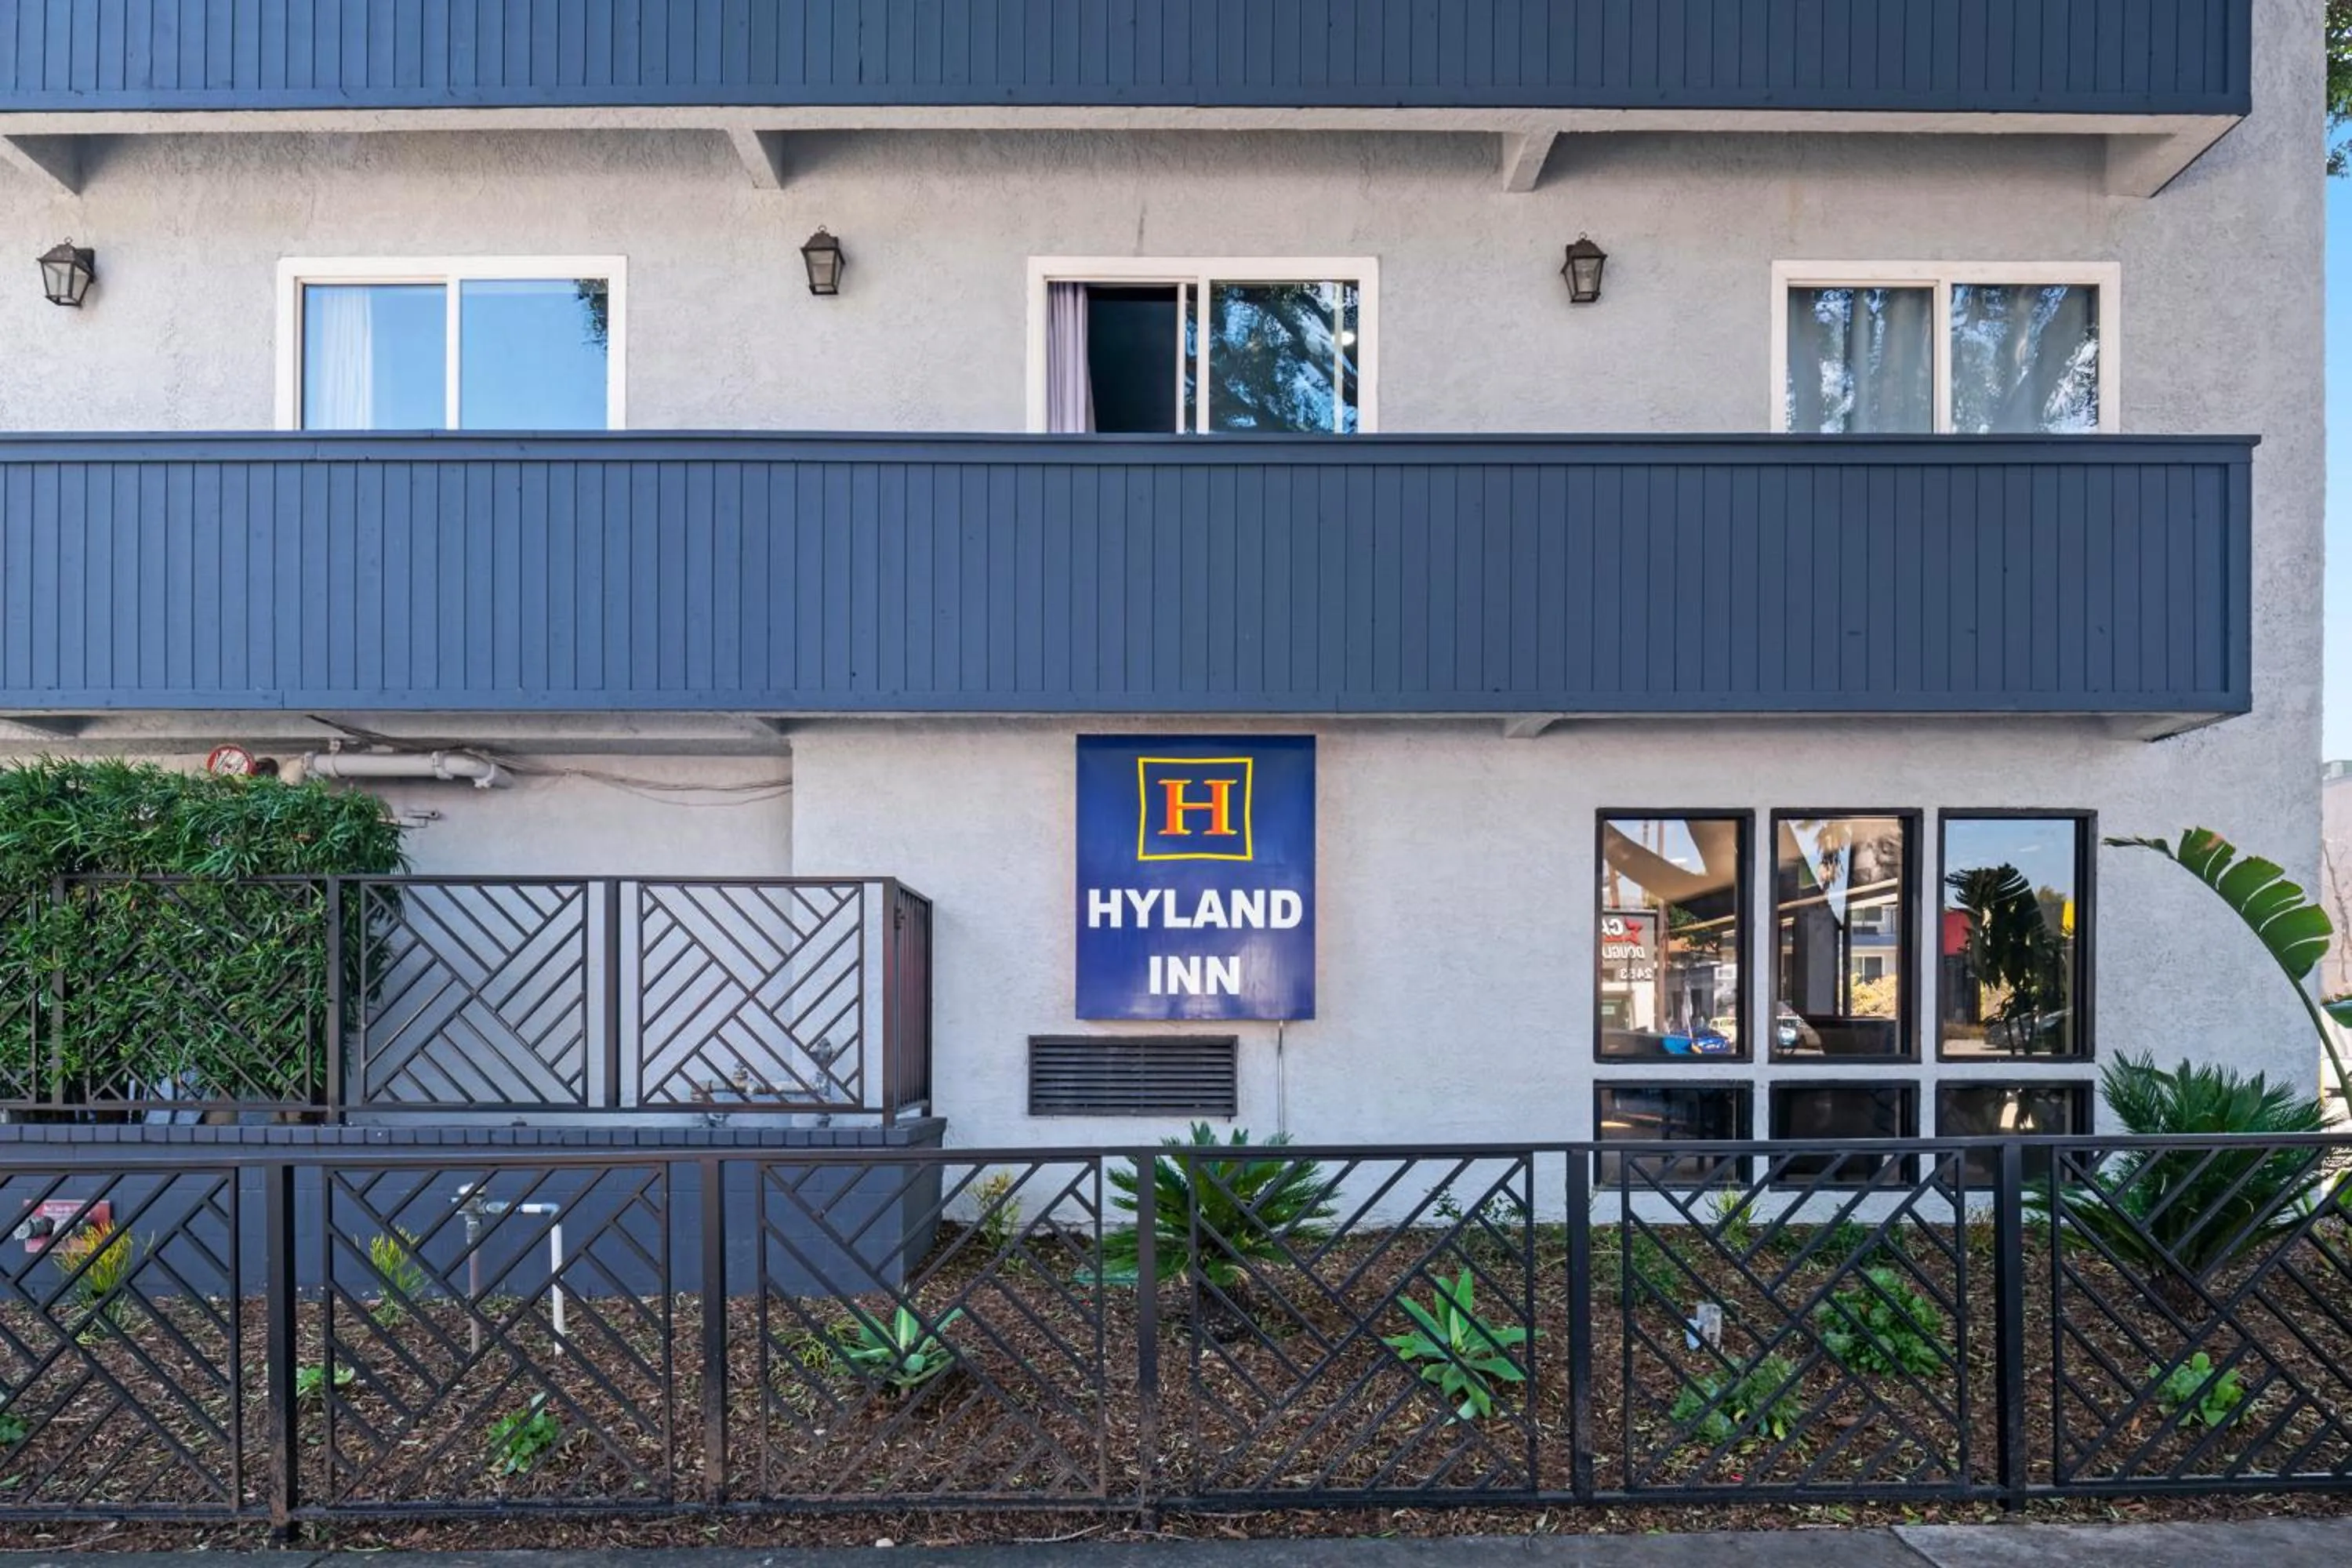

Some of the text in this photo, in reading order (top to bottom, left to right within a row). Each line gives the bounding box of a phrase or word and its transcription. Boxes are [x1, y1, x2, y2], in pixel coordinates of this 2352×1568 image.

[1158, 779, 1237, 835] H
[1088, 889, 1303, 928] HYLAND
[1149, 956, 1241, 995] INN
